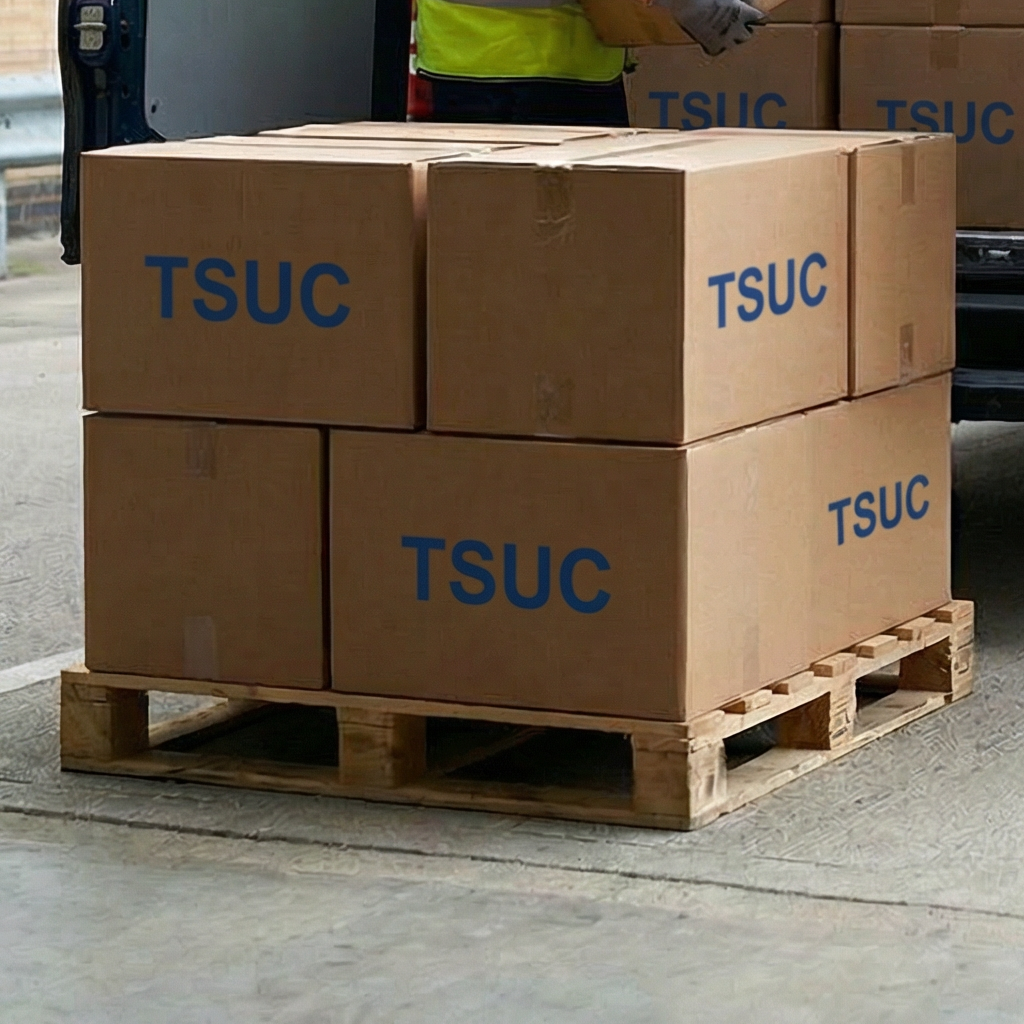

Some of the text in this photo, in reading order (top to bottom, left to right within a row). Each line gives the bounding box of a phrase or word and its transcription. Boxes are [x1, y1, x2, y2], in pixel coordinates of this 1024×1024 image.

[648, 91, 787, 130] TSUC
[876, 99, 1015, 145] TSUC
[144, 255, 350, 329] TSUC
[708, 252, 827, 329] TSUC
[828, 474, 929, 545] TSUC
[401, 535, 611, 615] TSUC
